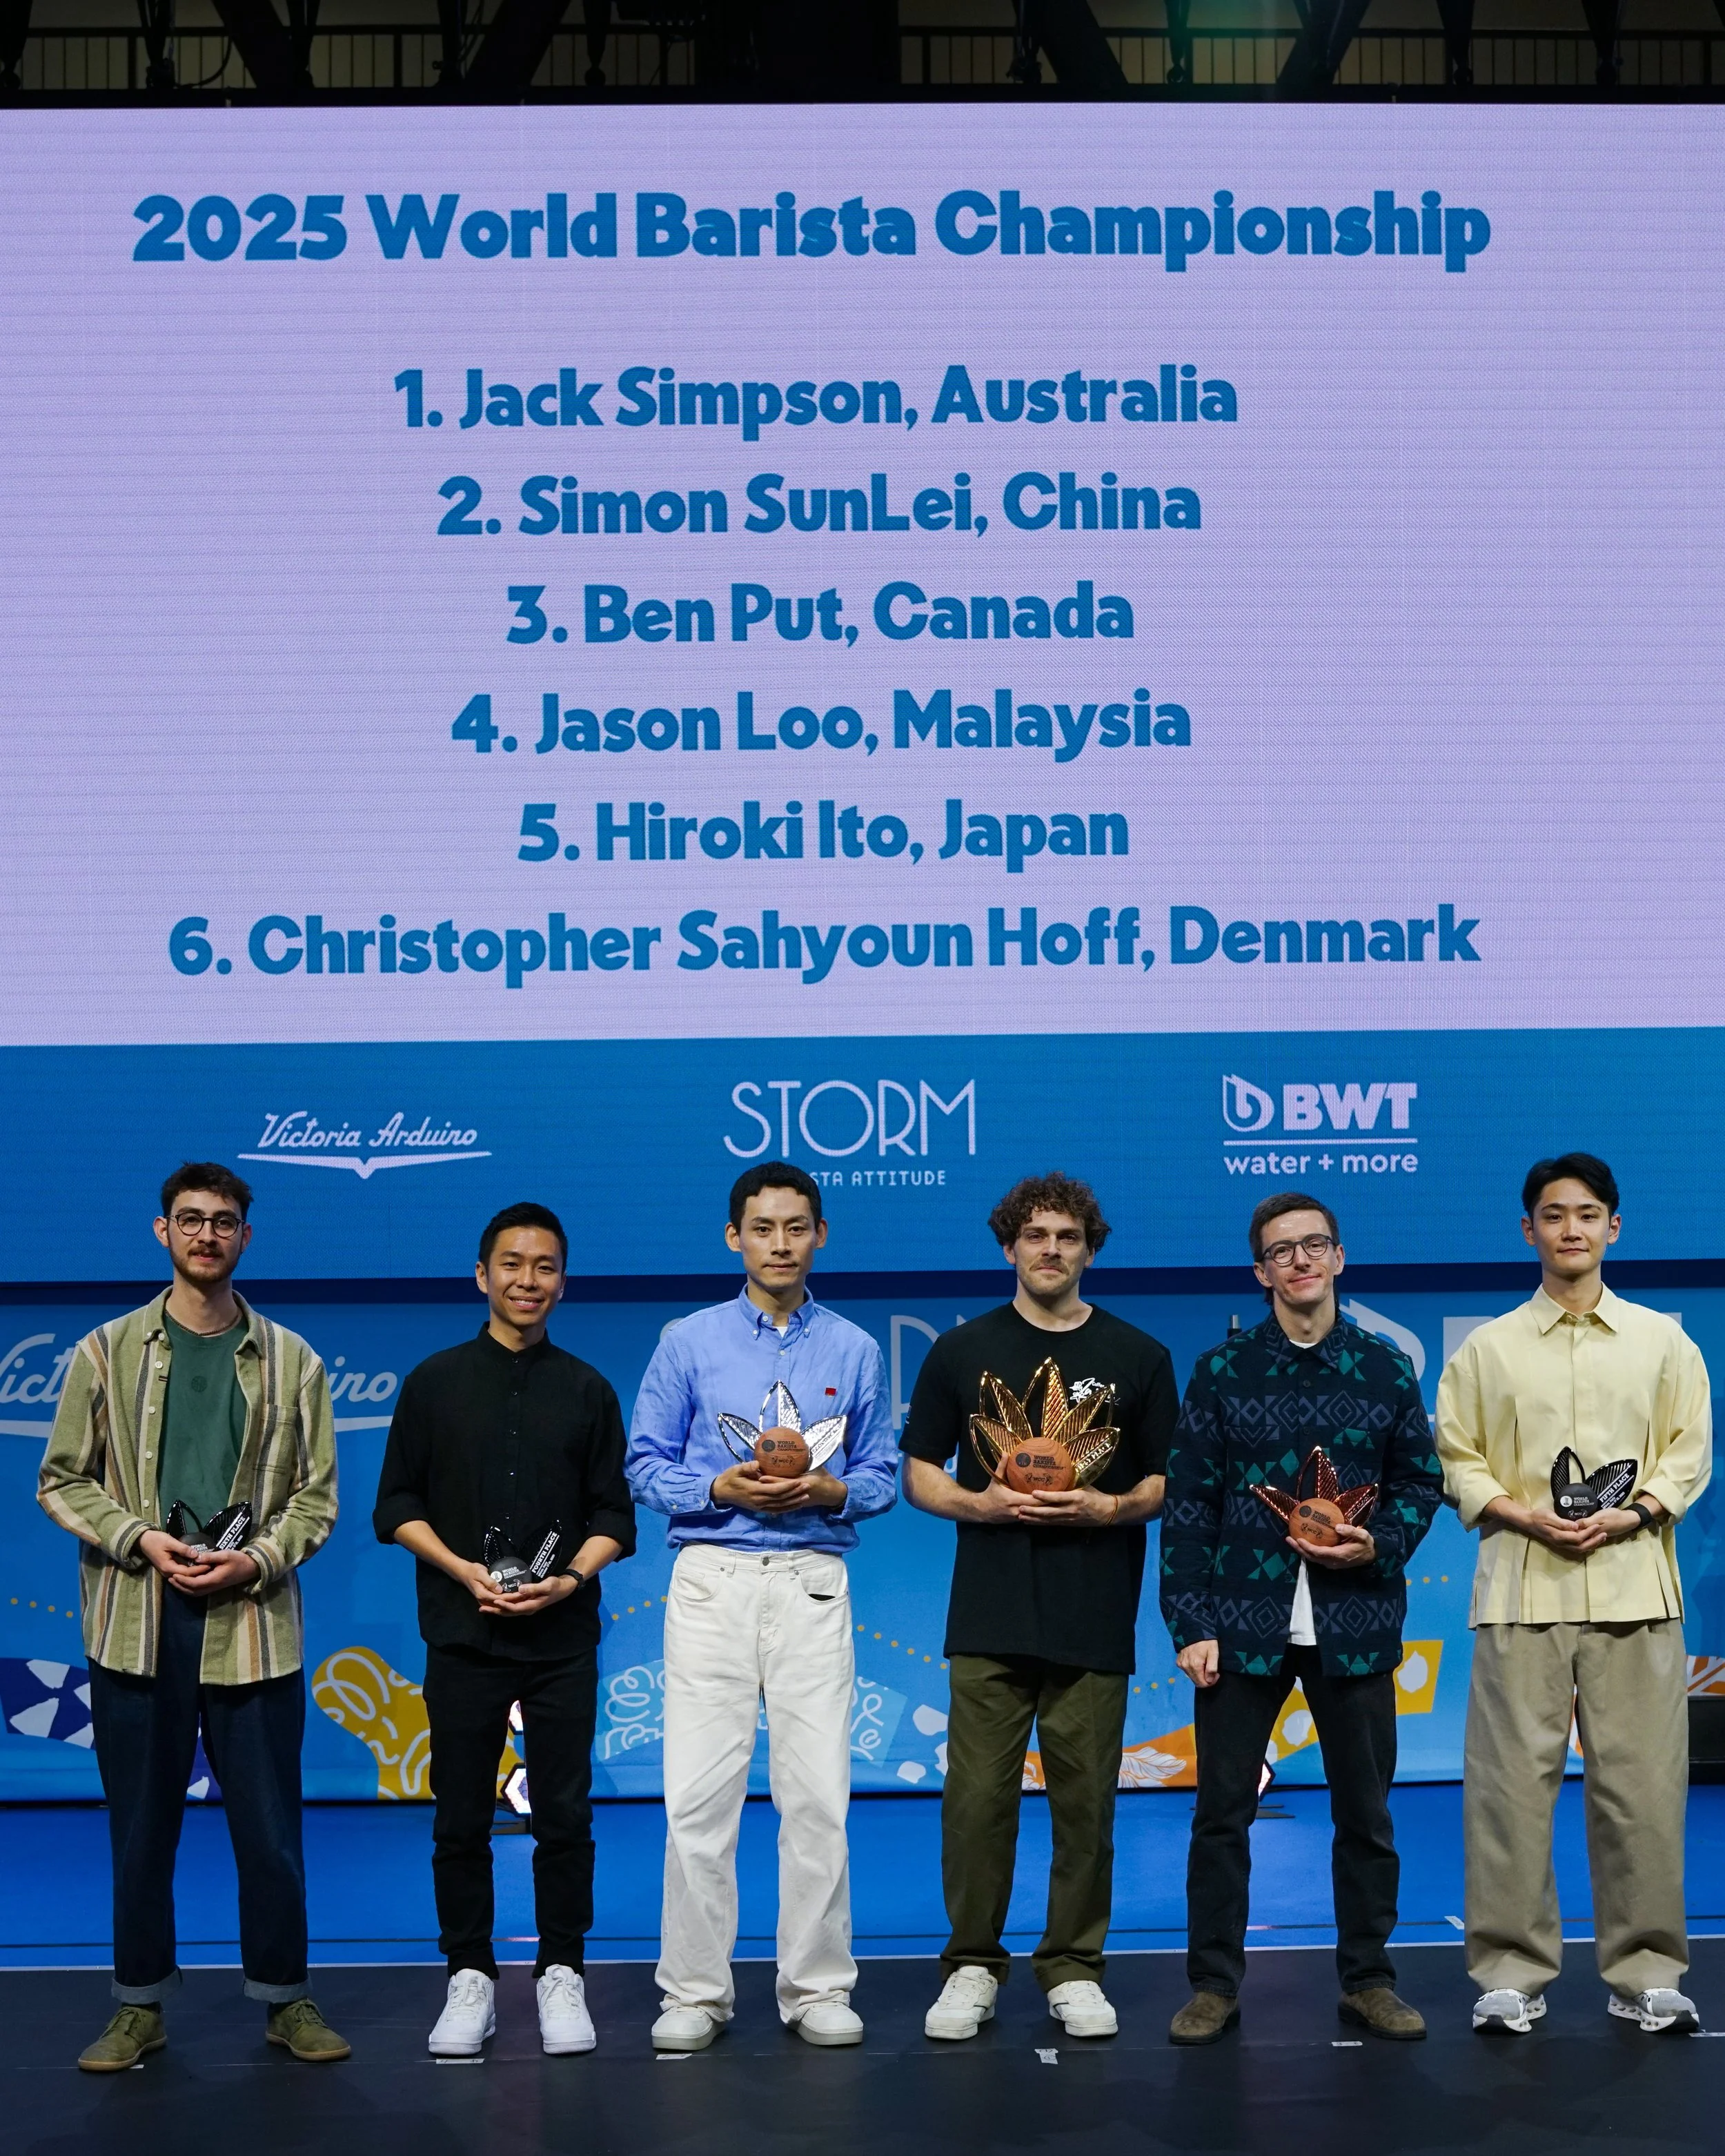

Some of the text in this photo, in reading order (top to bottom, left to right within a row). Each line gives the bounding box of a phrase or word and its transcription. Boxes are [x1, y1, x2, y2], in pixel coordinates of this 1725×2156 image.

[132, 190, 1490, 273] 2025 World Barista Championship
[394, 364, 1237, 442] 1. Jack Simpson, Australia
[437, 471, 1201, 537] 2. Simon SunLei, China
[506, 580, 1134, 647] 3. Ben Put, Canada
[451, 688, 1191, 763] 4. Jason Loo, Malaysia
[518, 799, 1129, 873] 5. Hiroki Ito, Japan
[168, 904, 1481, 989] 6. Christopher Sahyoun Hoff, Denmark
[258, 1111, 477, 1147] Victoria Arduino
[723, 1079, 976, 1158] STORM
[1283, 1082, 1417, 1131] BWT
[809, 1170, 946, 1186] STA ATTITUDE
[1223, 1152, 1419, 1174] water + more
[1599, 1473, 1630, 1503] FIFTH PLACE
[219, 1534, 233, 1550] SIXTH
[230, 1516, 246, 1534] PLACE
[531, 1532, 558, 1574] FOURTH PLACE
